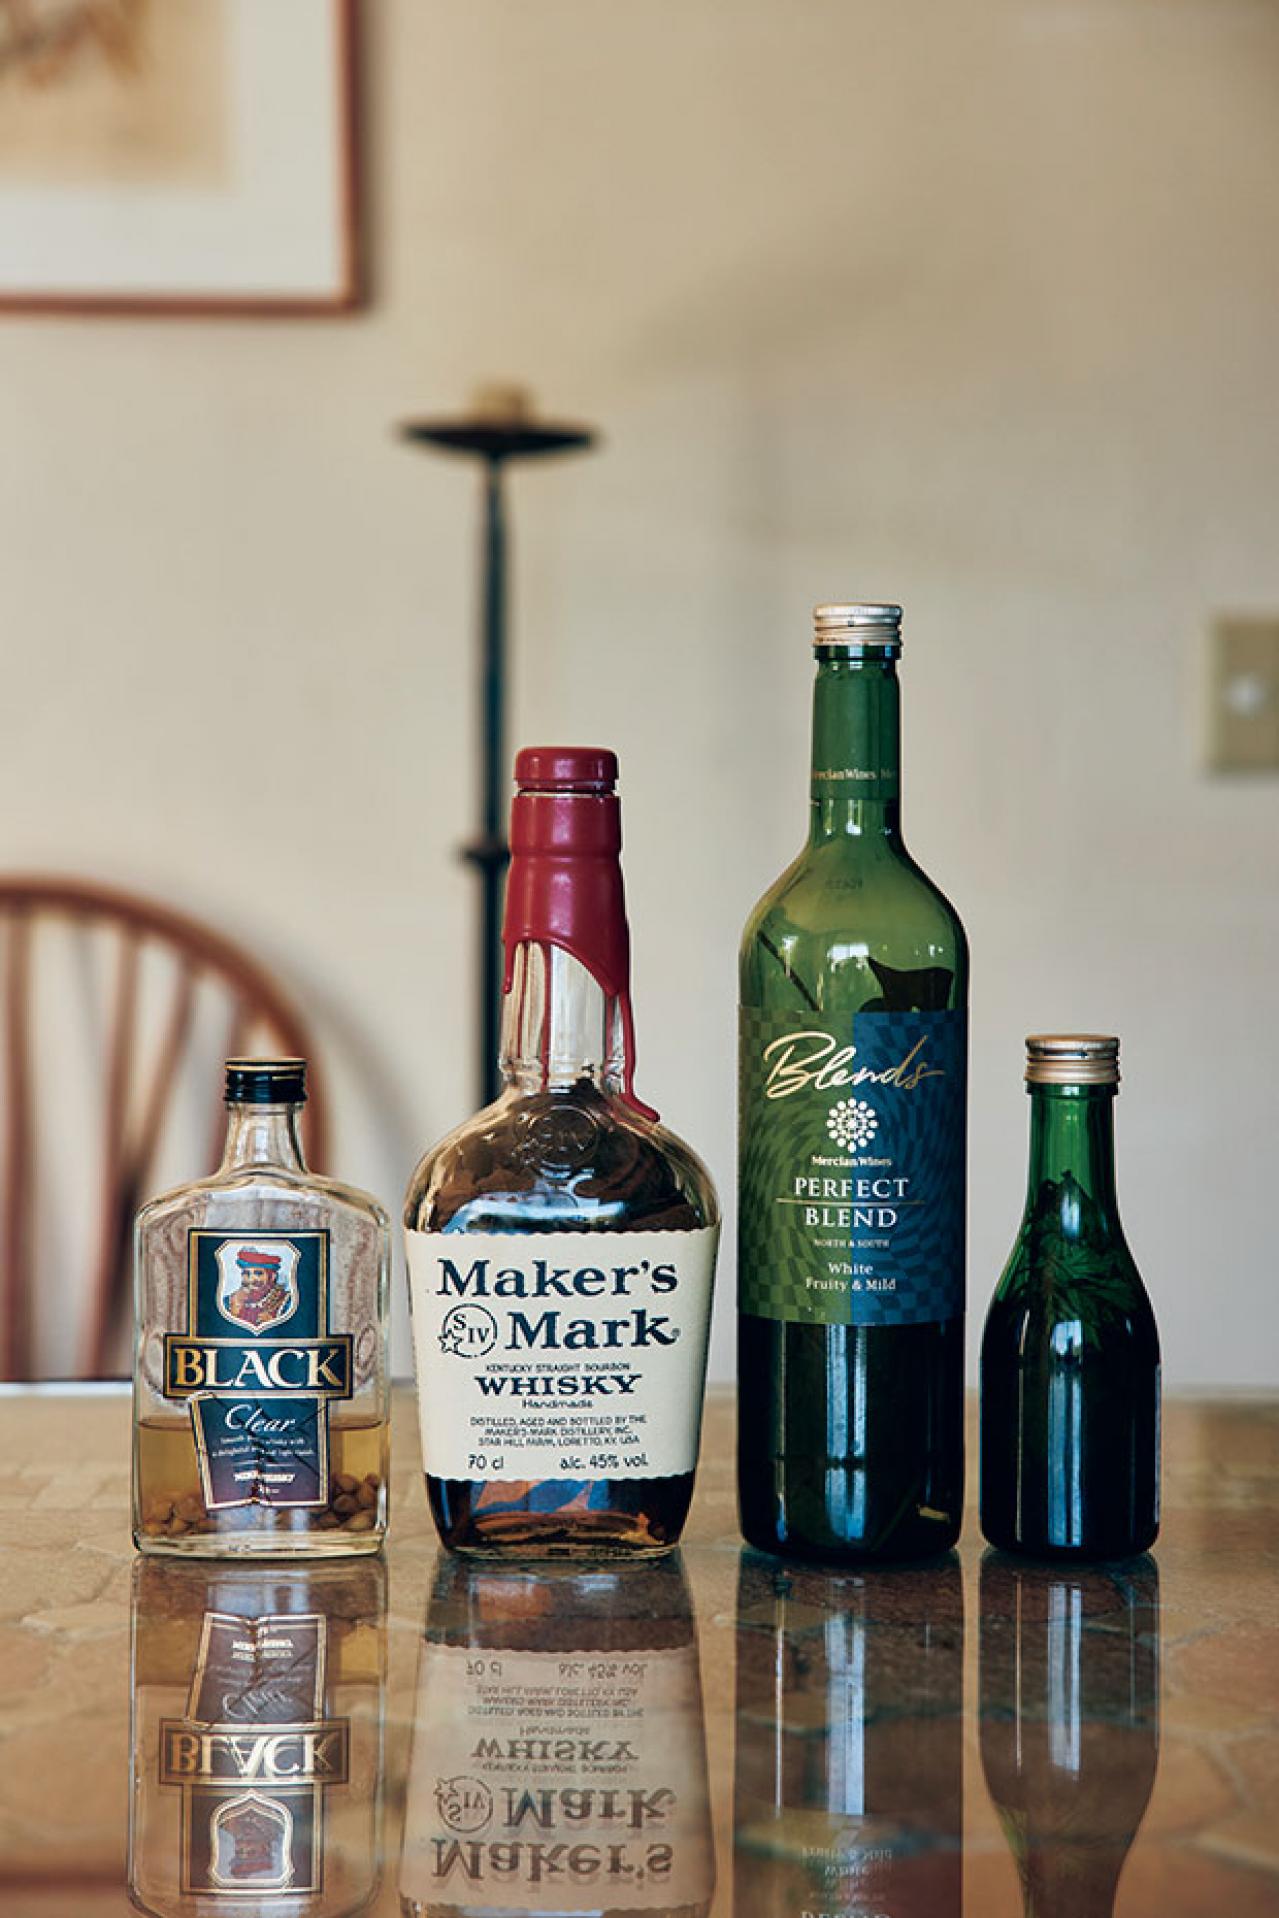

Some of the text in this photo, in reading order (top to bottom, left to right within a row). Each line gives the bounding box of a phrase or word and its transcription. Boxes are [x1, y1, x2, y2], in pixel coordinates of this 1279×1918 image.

[763, 1031, 945, 1099] Blends
[795, 1177, 909, 1198] PERFECT
[806, 1207, 897, 1228] BLEND
[436, 1258, 679, 1299] Maker's
[828, 1261, 874, 1275] White
[805, 1277, 897, 1293] Fruity & Mild
[174, 1348, 344, 1389] BLACK
[474, 1373, 643, 1396] WHISKY
[521, 1399, 594, 1409] Handmade
[225, 1404, 296, 1431] Clear
[468, 1454, 504, 1470] 70 cl
[560, 1455, 587, 1470] alc.
[590, 1454, 620, 1469] 45%
